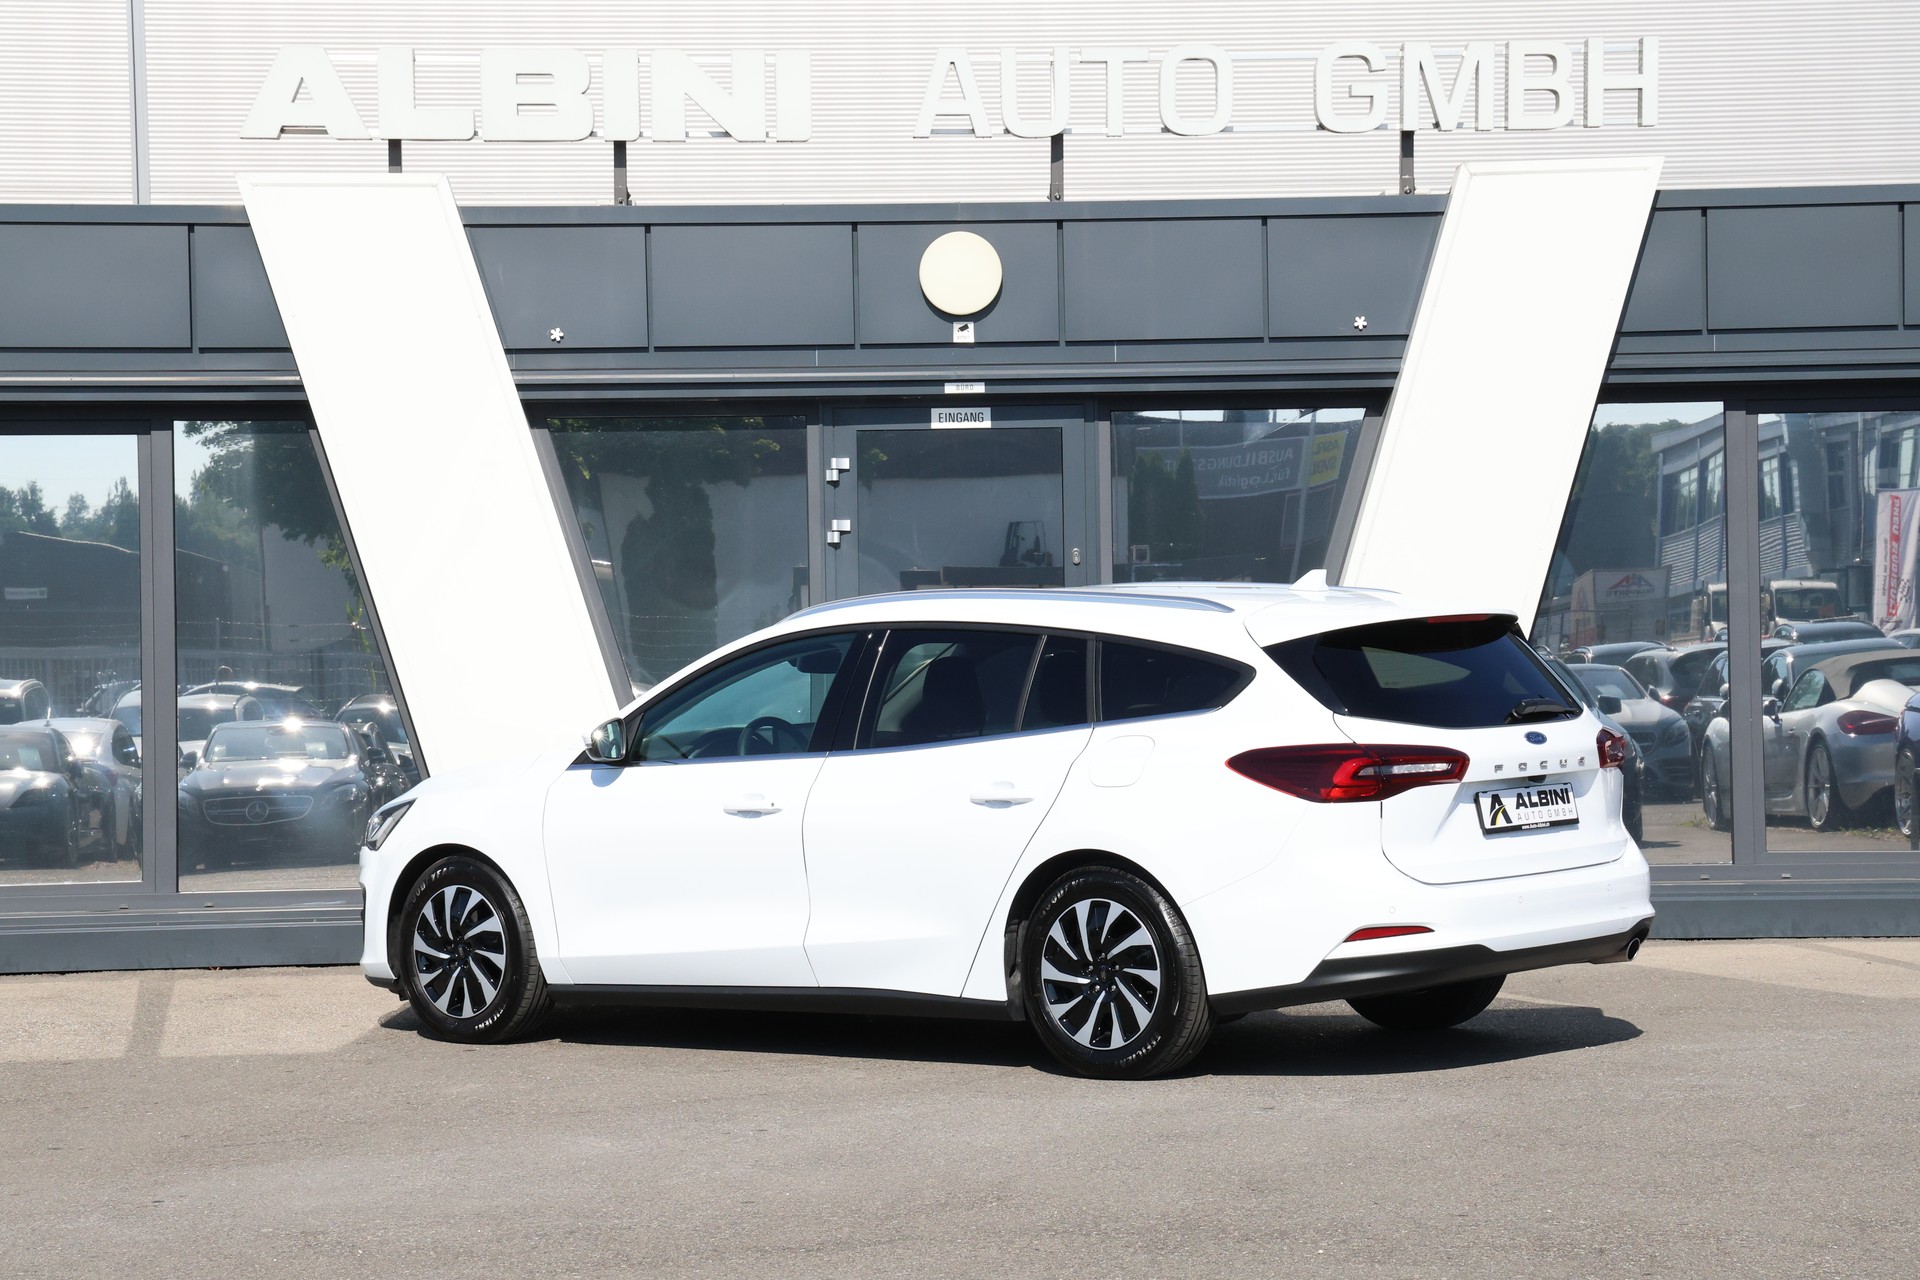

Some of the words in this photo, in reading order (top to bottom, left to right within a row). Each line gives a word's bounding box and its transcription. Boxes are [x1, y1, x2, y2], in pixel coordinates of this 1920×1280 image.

[239, 45, 812, 143] ALBINI
[912, 42, 1234, 139] AUTO
[1313, 36, 1659, 133] GMBH
[938, 411, 985, 424] EINGANG
[1515, 787, 1571, 810] ALBINI
[1516, 810, 1544, 822] AUTO
[1546, 807, 1574, 819] GMBH
